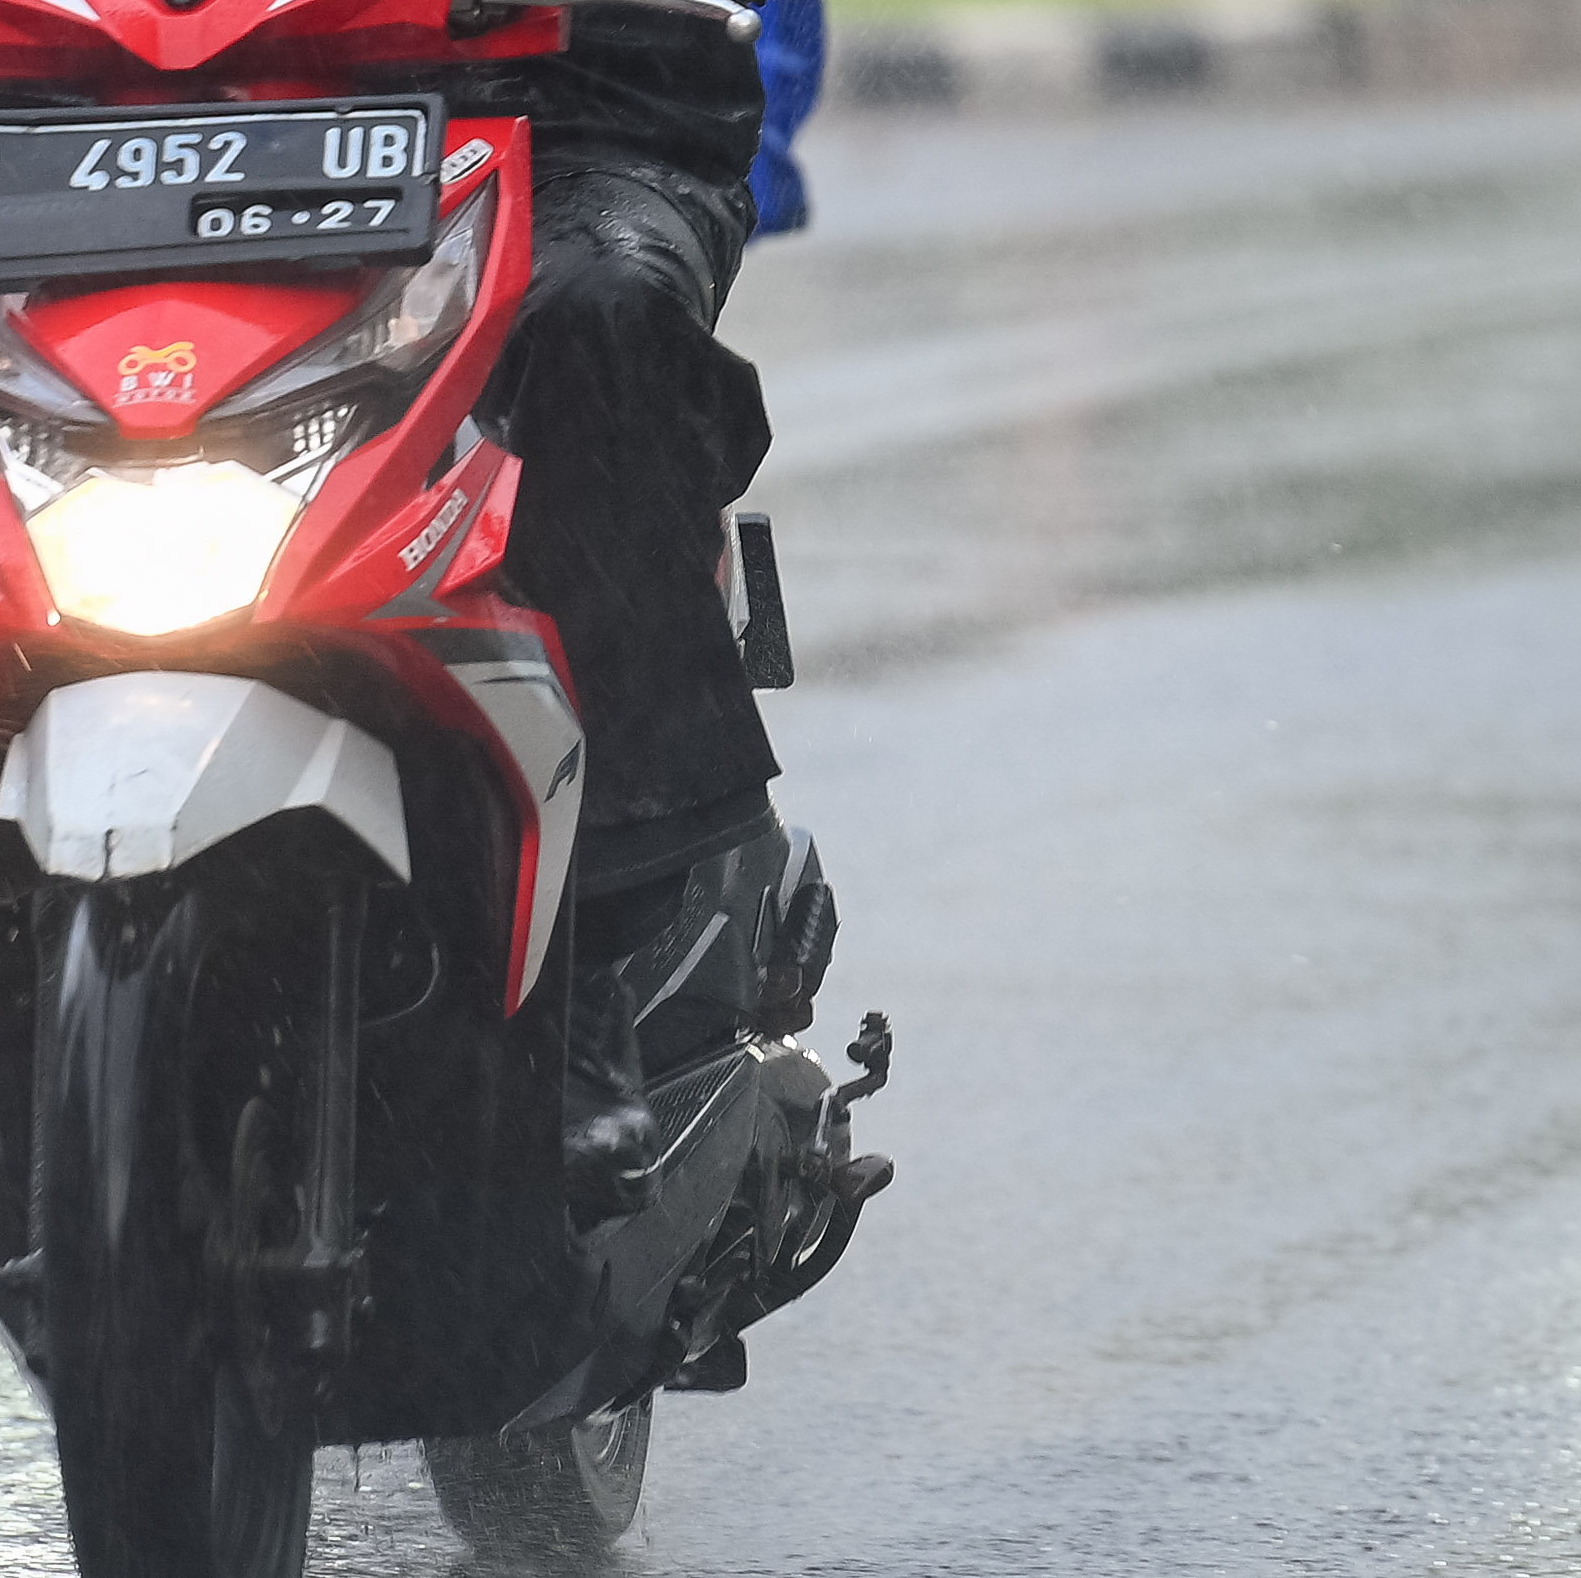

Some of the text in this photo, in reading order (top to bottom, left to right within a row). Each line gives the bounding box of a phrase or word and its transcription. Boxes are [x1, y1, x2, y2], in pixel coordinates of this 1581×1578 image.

[69, 130, 248, 192] 4952
[321, 124, 409, 179] UB
[397, 487, 469, 572] HONDA
